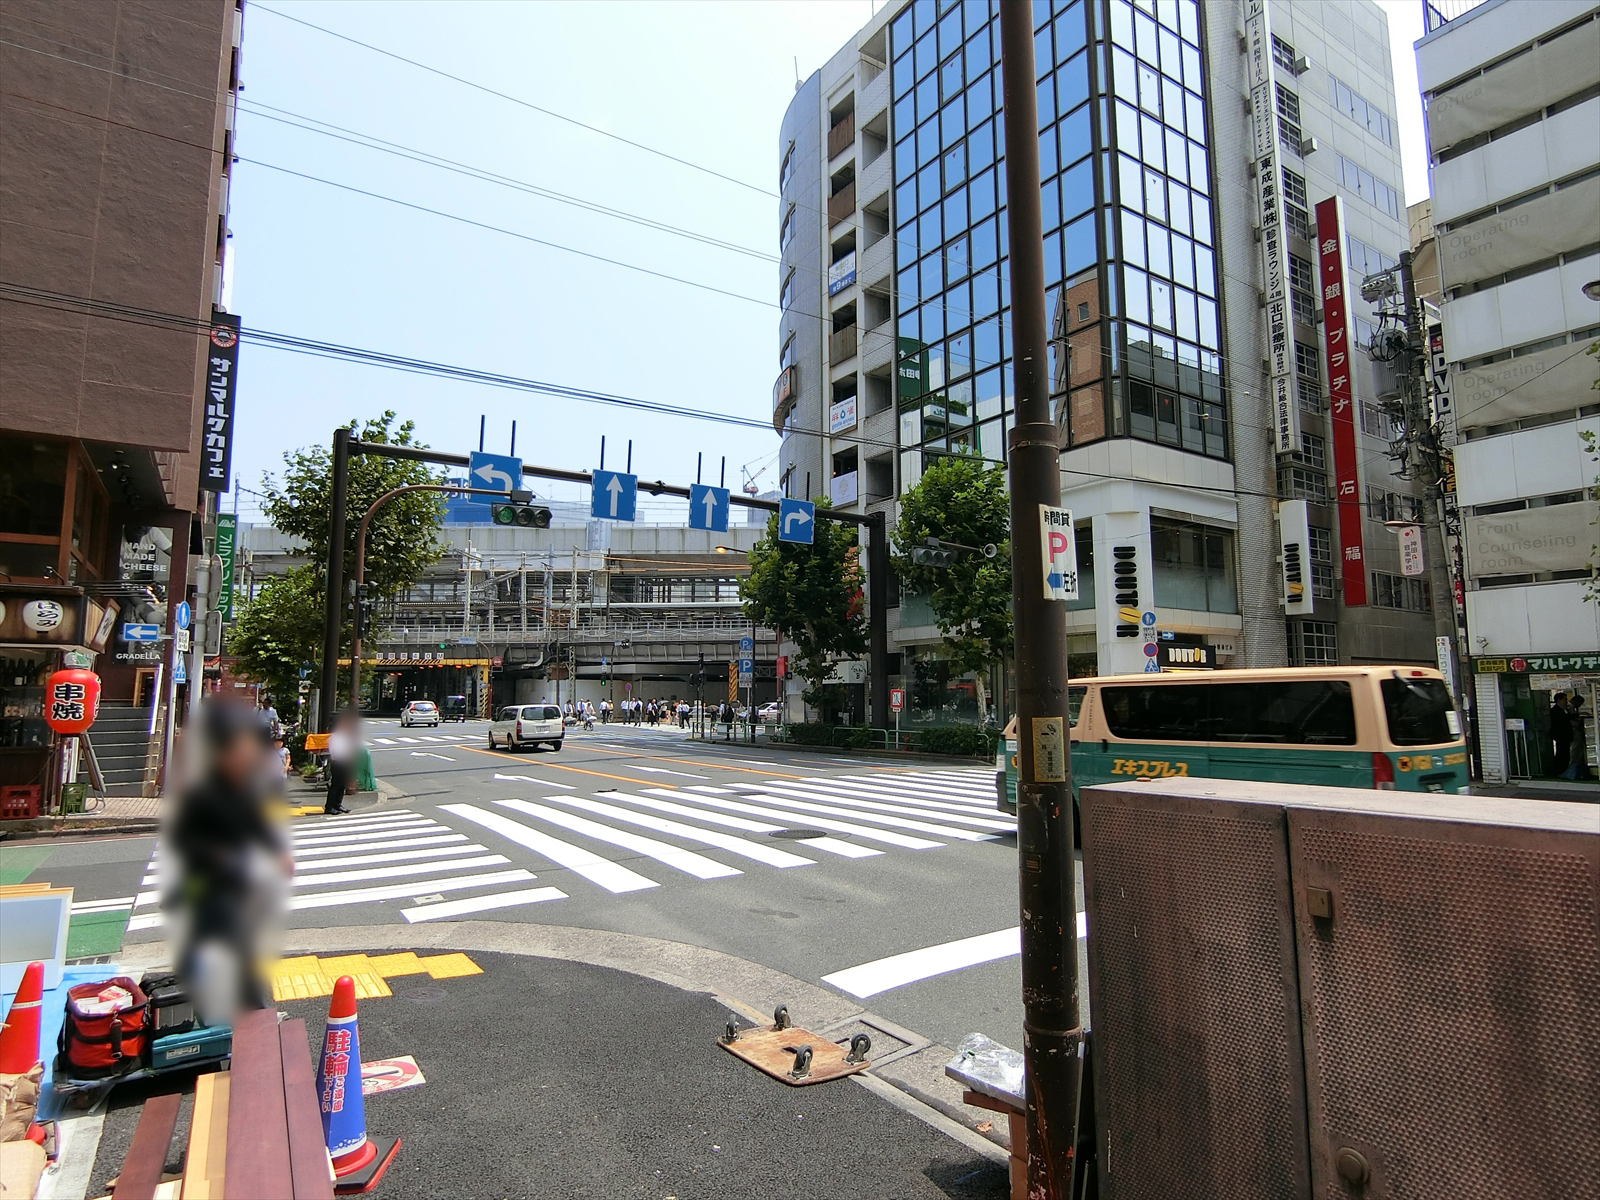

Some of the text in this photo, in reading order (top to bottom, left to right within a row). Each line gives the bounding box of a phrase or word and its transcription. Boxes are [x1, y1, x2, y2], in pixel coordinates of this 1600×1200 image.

[1450, 213, 1530, 248] Operating
[1453, 241, 1493, 262] room
[1270, 303, 1285, 353] 北口診療所
[1433, 353, 1451, 413] DVD
[1463, 360, 1546, 389] Operating
[1466, 385, 1508, 402] room
[206, 357, 232, 478] サンマルクカフェ
[1477, 521, 1521, 536] Front
[124, 542, 156, 551] HAND
[1048, 531, 1068, 564] P
[1478, 534, 1576, 554] Counseling
[123, 552, 156, 561] MADE
[1481, 555, 1524, 570] room
[122, 572, 130, 580] &
[123, 562, 167, 572] CHEESE
[37, 602, 59, 626] はらみ
[116, 652, 161, 660] GRADELLA
[1168, 647, 1207, 663] DOUTOR
[1527, 656, 1600, 671] マルトクチ
[52, 682, 85, 721] 串焼
[1110, 759, 1189, 778] エキスプレス
[323, 1028, 352, 1078] 駐輪
